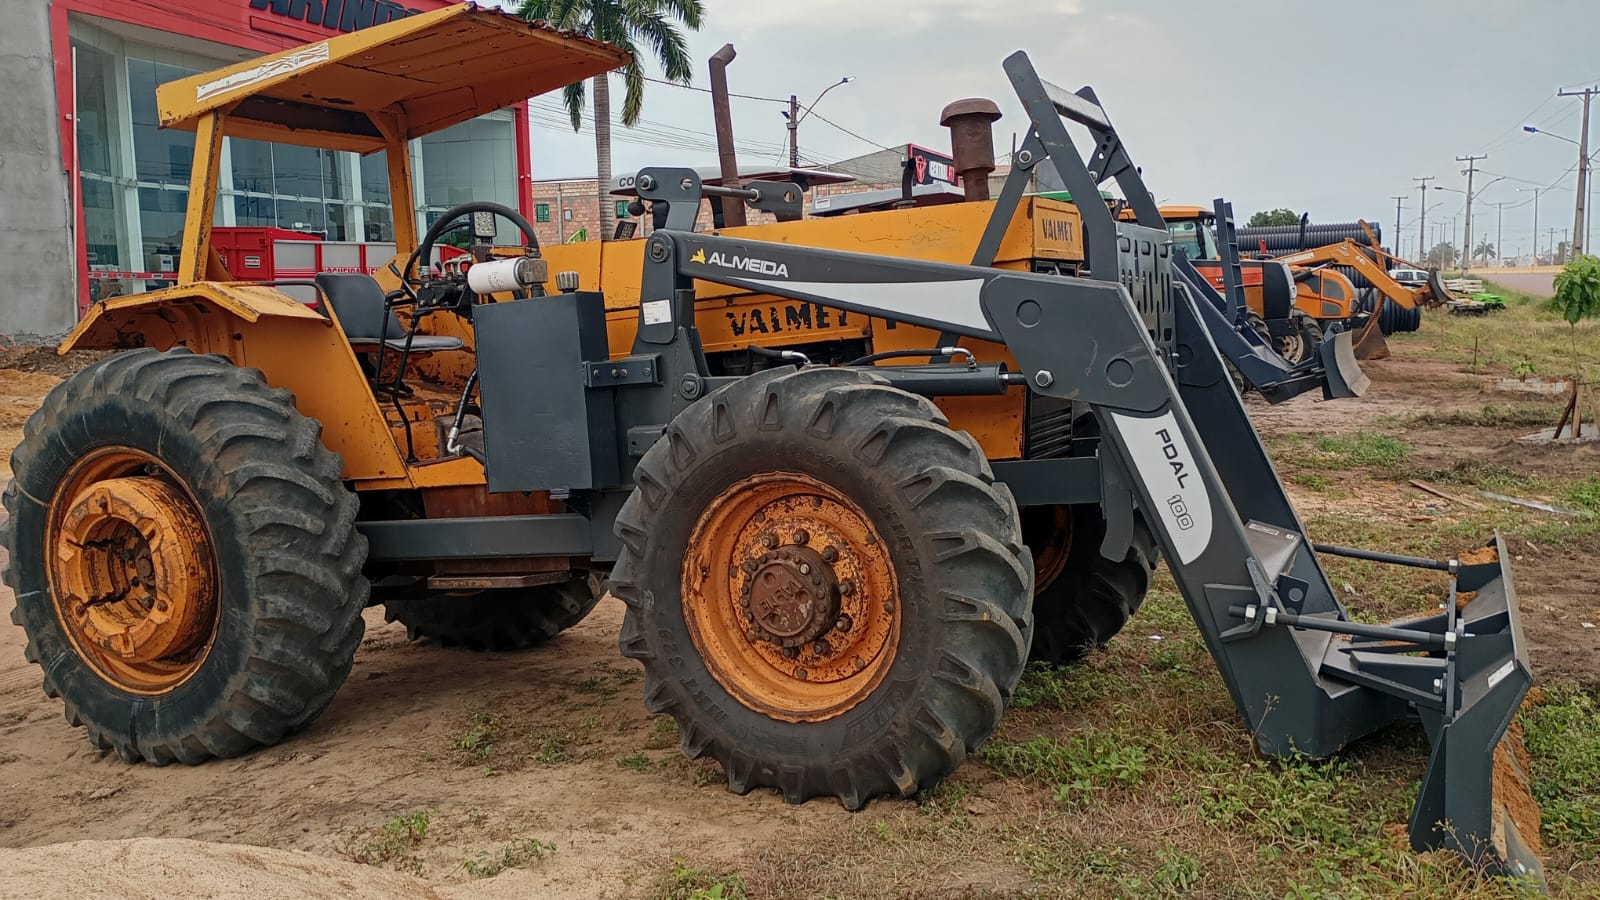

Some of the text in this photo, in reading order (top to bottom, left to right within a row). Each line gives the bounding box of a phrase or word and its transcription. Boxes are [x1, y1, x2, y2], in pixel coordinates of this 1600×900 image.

[1042, 218, 1073, 242] VALMET
[708, 251, 789, 278] ALMEIDA
[1155, 428, 1194, 531] PDAL 100
